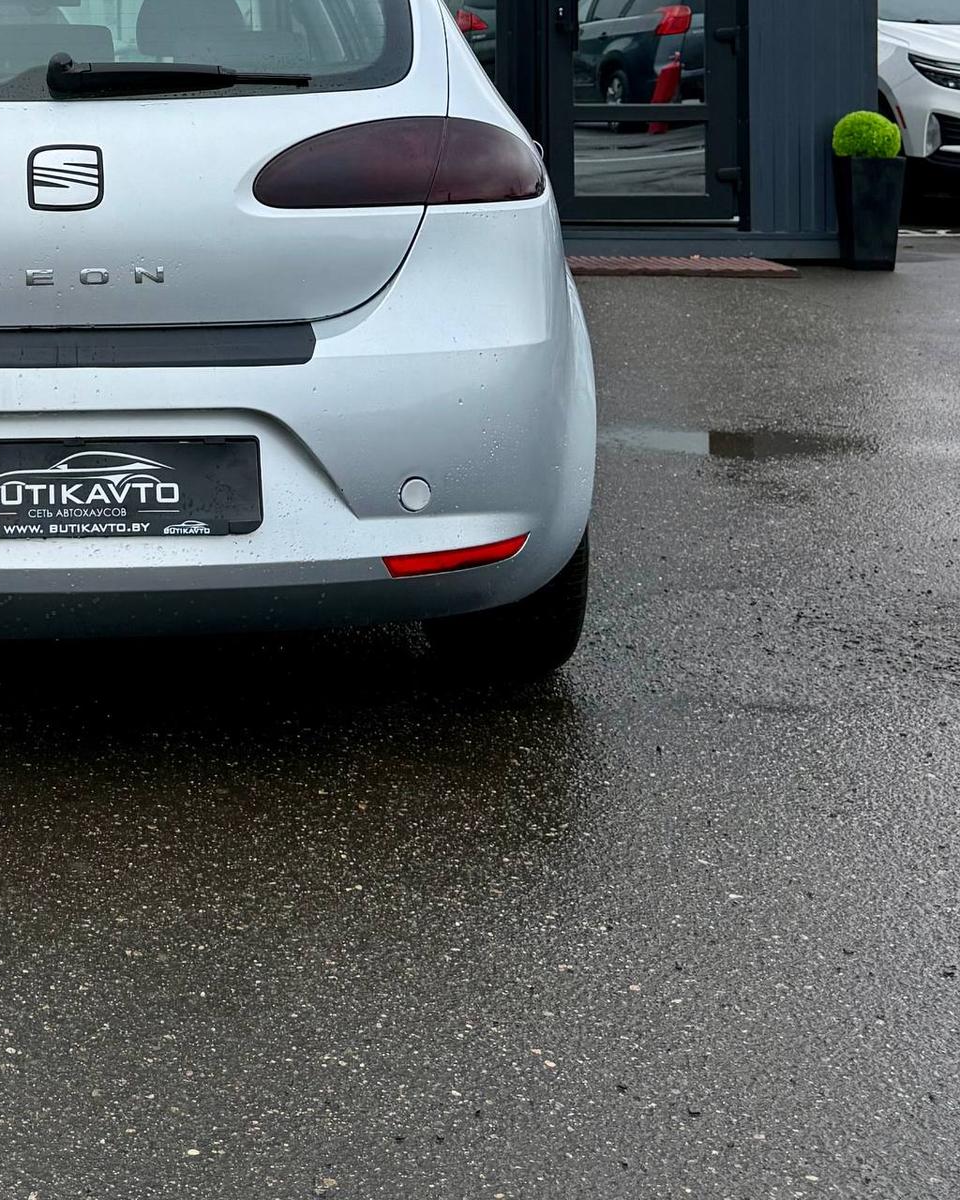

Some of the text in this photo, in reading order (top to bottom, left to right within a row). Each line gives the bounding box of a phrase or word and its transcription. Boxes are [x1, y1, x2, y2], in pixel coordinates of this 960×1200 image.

[28, 507, 127, 518] СЕТЬ АВТОХАУСОВ
[3, 522, 150, 535] WWW. BUTIKAVTO.BY
[163, 527, 211, 535] BUTIKAVTO
